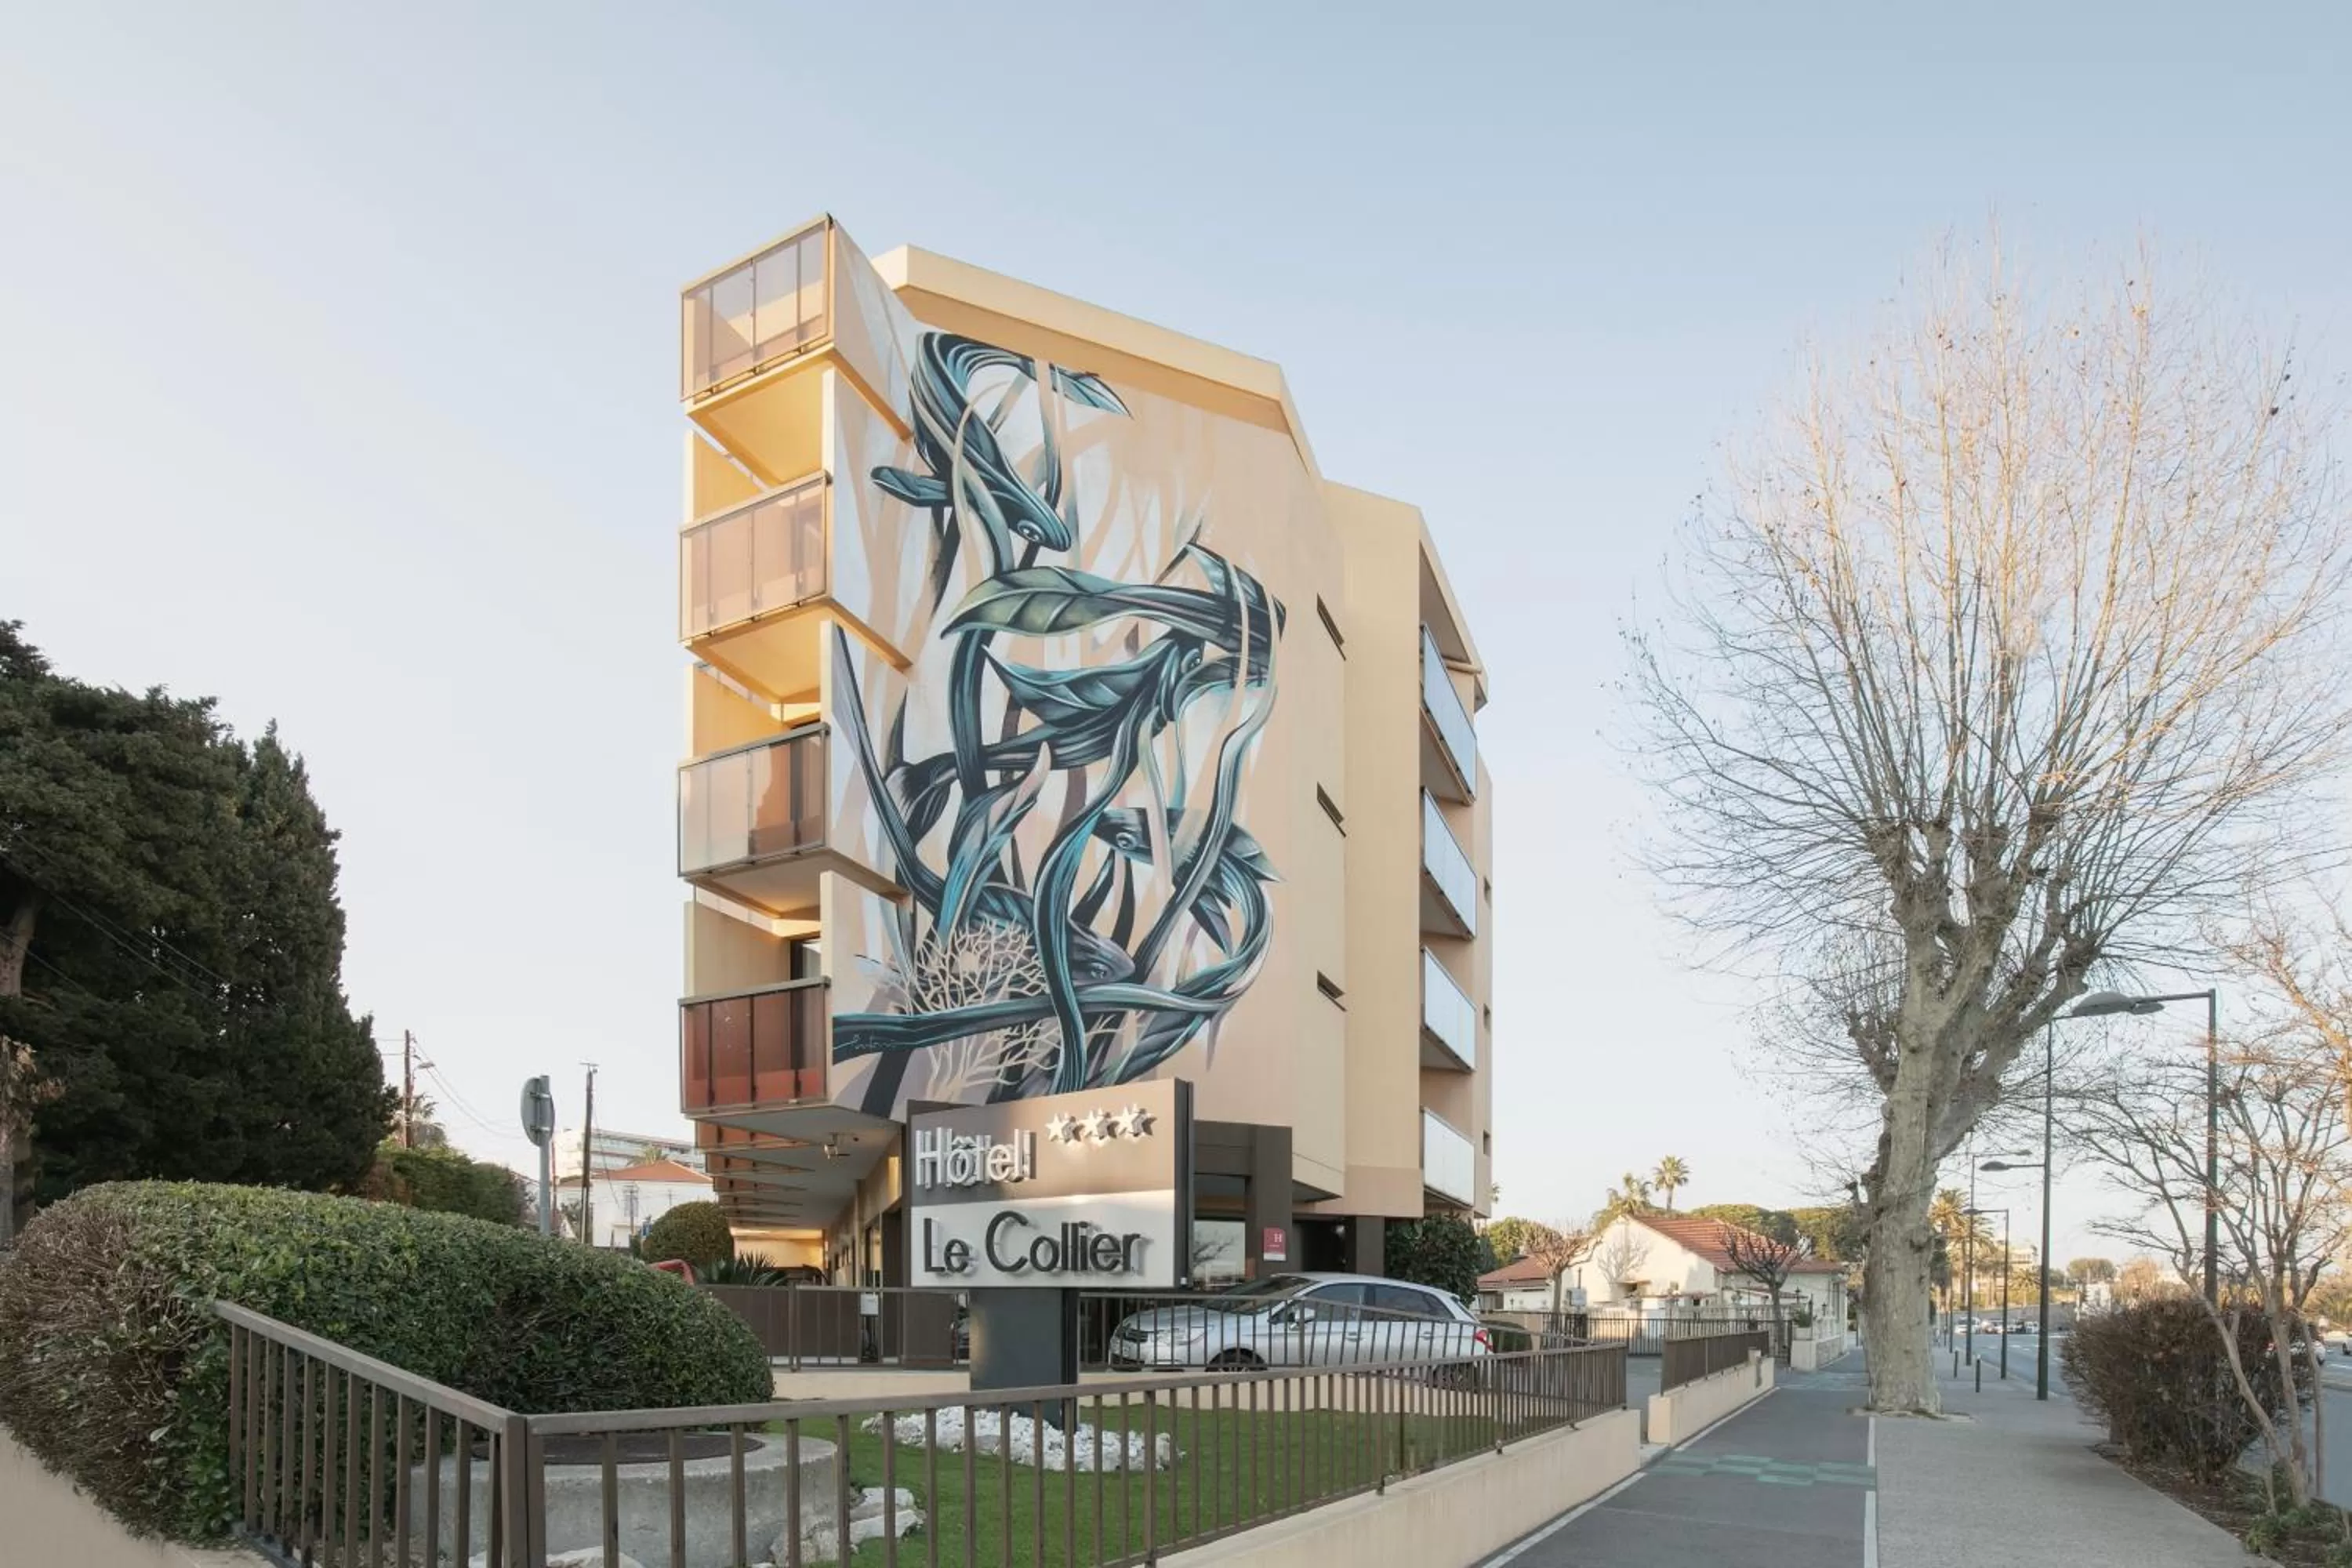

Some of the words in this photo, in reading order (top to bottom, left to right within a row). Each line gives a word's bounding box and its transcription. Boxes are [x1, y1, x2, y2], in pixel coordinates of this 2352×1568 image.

[915, 1127, 1030, 1186] Hôtel
[924, 1218, 971, 1272] Le
[985, 1210, 1141, 1272] Collier
